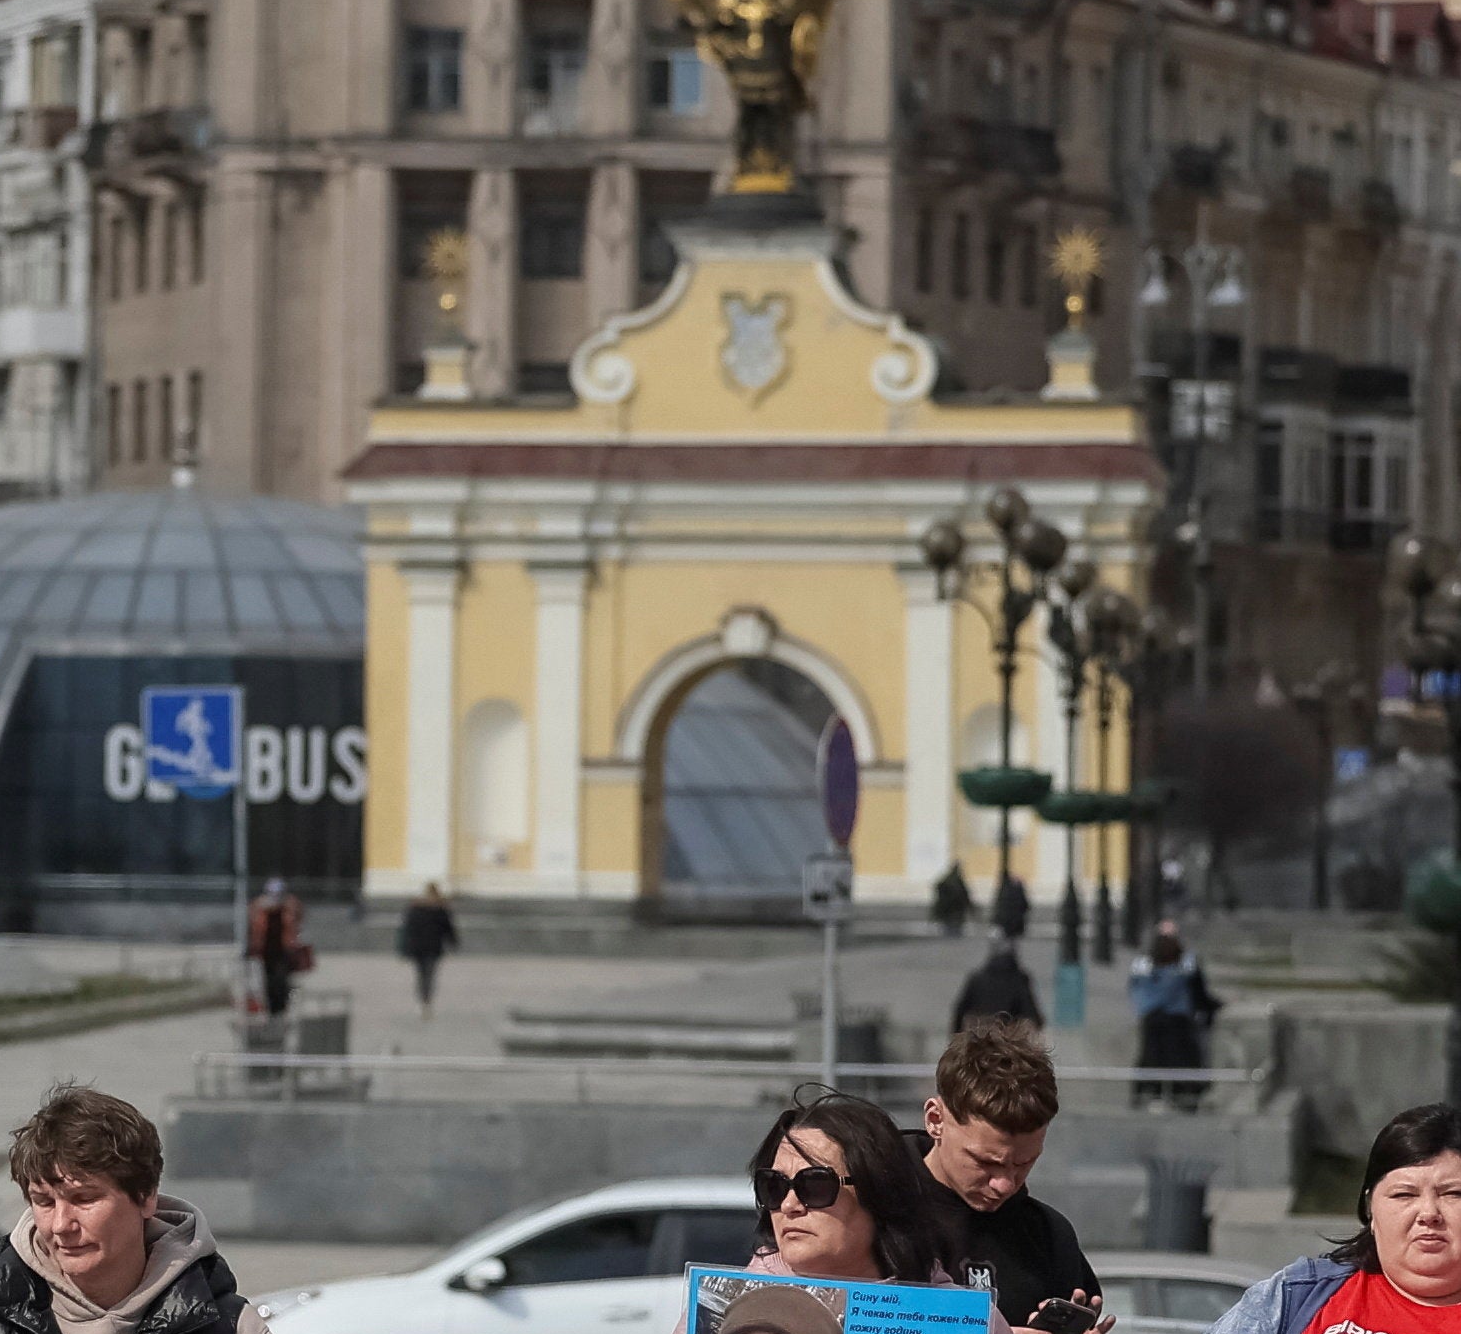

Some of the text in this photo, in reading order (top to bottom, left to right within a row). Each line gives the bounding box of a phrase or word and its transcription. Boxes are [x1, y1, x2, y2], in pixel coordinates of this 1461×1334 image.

[103, 724, 368, 802] GBUS
[852, 1291, 879, 1304] Сину
[851, 1307, 860, 1316] Я
[862, 1310, 894, 1320] чекаю
[897, 1312, 925, 1322] тебе
[927, 1315, 959, 1324] кожен
